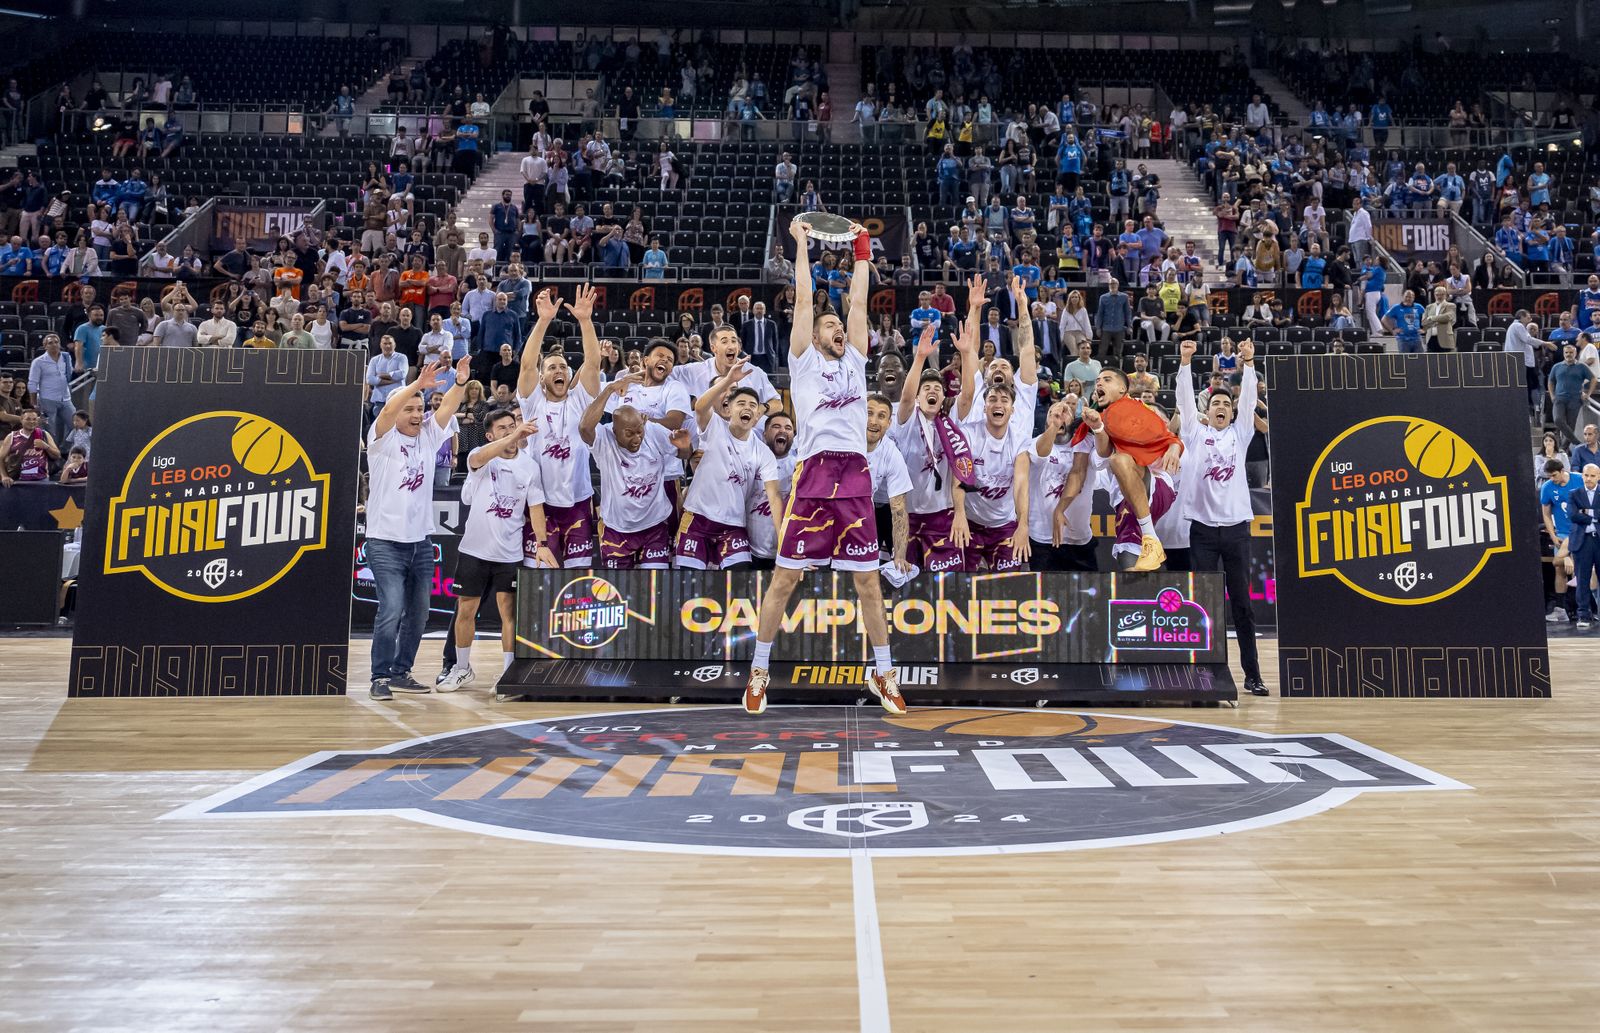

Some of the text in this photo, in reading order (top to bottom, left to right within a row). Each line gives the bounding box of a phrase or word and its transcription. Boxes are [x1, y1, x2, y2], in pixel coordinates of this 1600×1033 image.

[152, 455, 176, 469] Liga
[1330, 461, 1353, 474] Liga
[151, 464, 232, 485] LEB ORO
[1332, 468, 1408, 490] LEB ORO
[184, 481, 255, 497] MADRID
[1365, 485, 1433, 501] MADRID
[684, 539, 698, 552] 24
[796, 540, 805, 554] 6
[187, 569, 243, 577] 20 24
[1379, 572, 1433, 580] 20 24
[1118, 611, 1145, 628] ICG
[1152, 609, 1189, 627] força
[1153, 627, 1201, 643] lleida
[545, 724, 642, 734] Liga
[713, 731, 891, 741] ORO
[684, 739, 1005, 751] MADRID
[686, 813, 1031, 824] 20 24
